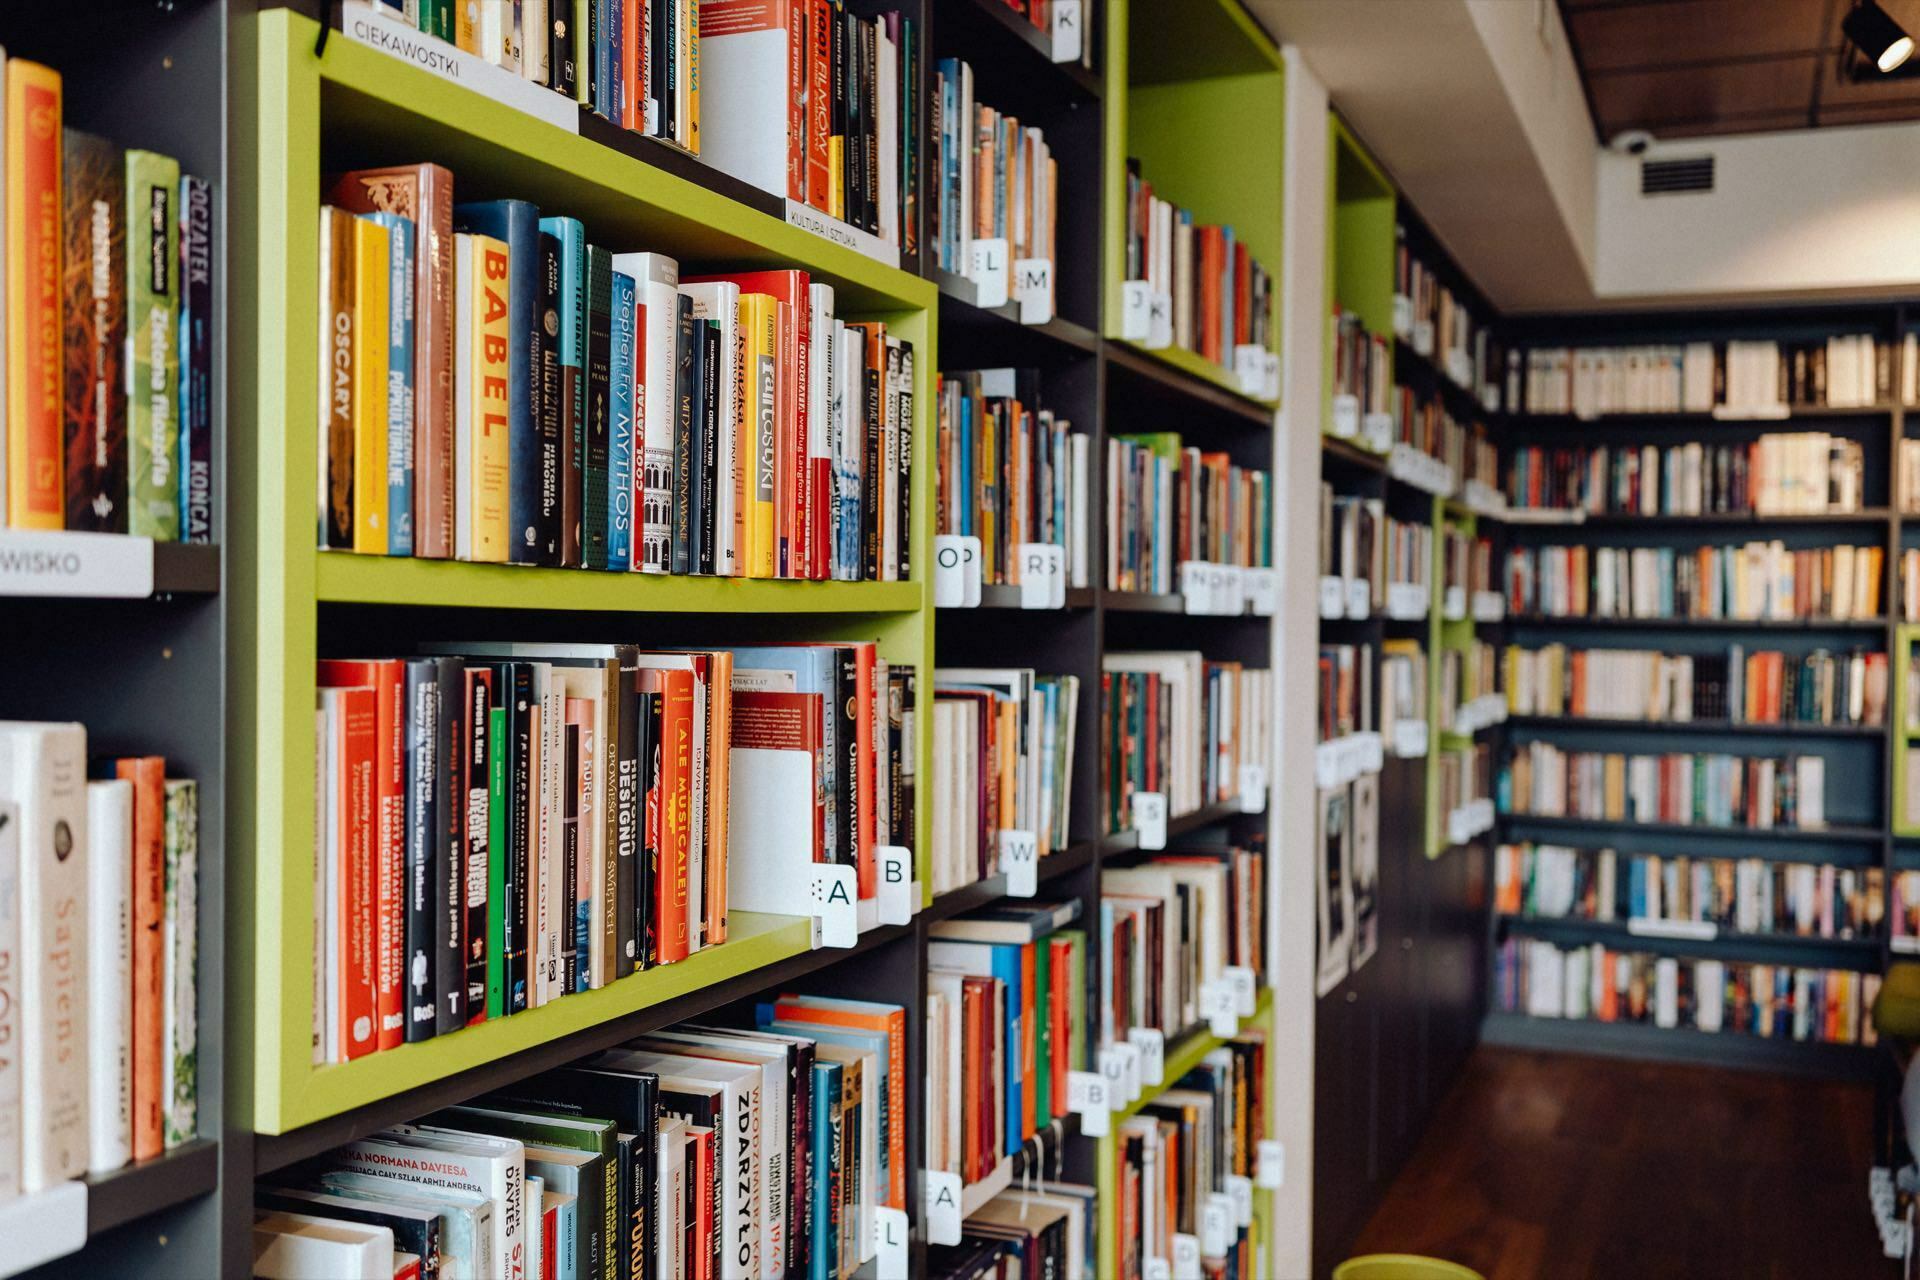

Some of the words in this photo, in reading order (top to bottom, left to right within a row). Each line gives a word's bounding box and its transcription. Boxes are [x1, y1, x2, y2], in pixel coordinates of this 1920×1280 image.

[818, 7, 827, 58] 1001
[1060, 9, 1074, 27] K
[354, 19, 460, 78] CIEKAWOSTKI
[42, 190, 57, 299] SIMONA
[790, 210, 826, 239] KULTURA
[829, 226, 858, 248] SZTUKA
[987, 251, 999, 271] L
[1026, 270, 1047, 290] M
[619, 288, 633, 367] Stephen
[665, 299, 673, 332] STYLE
[665, 335, 673, 346] W
[731, 302, 739, 347] KSIĘGA
[42, 305, 57, 413] KOSSAK
[150, 307, 169, 391] Zielona
[335, 312, 350, 420] OSCARY
[484, 249, 507, 437] BABEL
[616, 373, 631, 404] Fry
[798, 342, 806, 413] FOTOGRAFIA
[635, 383, 645, 441] JAPAN
[682, 394, 691, 426] MITY
[761, 361, 775, 492] fantastyki
[150, 394, 171, 487] filozofia
[543, 443, 551, 518] FENOMENU
[615, 412, 630, 531] MYTHOS
[636, 445, 645, 492] COOL
[679, 430, 690, 543] SKANDYNAWSKIE
[796, 455, 804, 505] Langforda
[938, 547, 958, 569] O
[1028, 555, 1043, 575] R
[475, 685, 486, 726] Steven
[705, 682, 713, 760] BESTIARIUSZ
[474, 739, 485, 765] Katz
[475, 727, 485, 738] D.
[678, 728, 688, 769] ALE
[825, 701, 835, 790] LONDYN
[583, 760, 593, 814] KOREA
[607, 743, 617, 824] OPOWIEŚCI
[618, 760, 631, 857] DESIGNU
[849, 742, 858, 858] OBSERWATORZY
[382, 797, 392, 901] KANONICZNYCH
[678, 776, 688, 897] MUSICALE!
[1010, 838, 1033, 862] W
[605, 860, 617, 936] ŚWIĘTYCH
[829, 880, 851, 905] A
[885, 860, 902, 883] B
[449, 909, 458, 949] Paweł
[47, 896, 77, 1066] Sapiens
[448, 990, 459, 1014] T
[1089, 1084, 1103, 1104] B
[1105, 1063, 1120, 1079] U
[364, 1156, 419, 1177] NORMANA
[420, 1165, 469, 1188] DAVIESA
[378, 1173, 398, 1187] CAŁY
[397, 1177, 422, 1190] SZLAK
[422, 1179, 446, 1194] ARMII
[446, 1182, 483, 1195] ANDERSA
[738, 1091, 751, 1267] ZDARZYŁO
[752, 1086, 761, 1233] WŁODZIMIERZ
[774, 1152, 782, 1219] POWSTANIE
[505, 1165, 515, 1238] DAVIES
[514, 1166, 522, 1228] NORMAN
[830, 1170, 841, 1225] Polski
[936, 1185, 952, 1207] A
[770, 1223, 781, 1275] 1944
[886, 1224, 898, 1246] L
